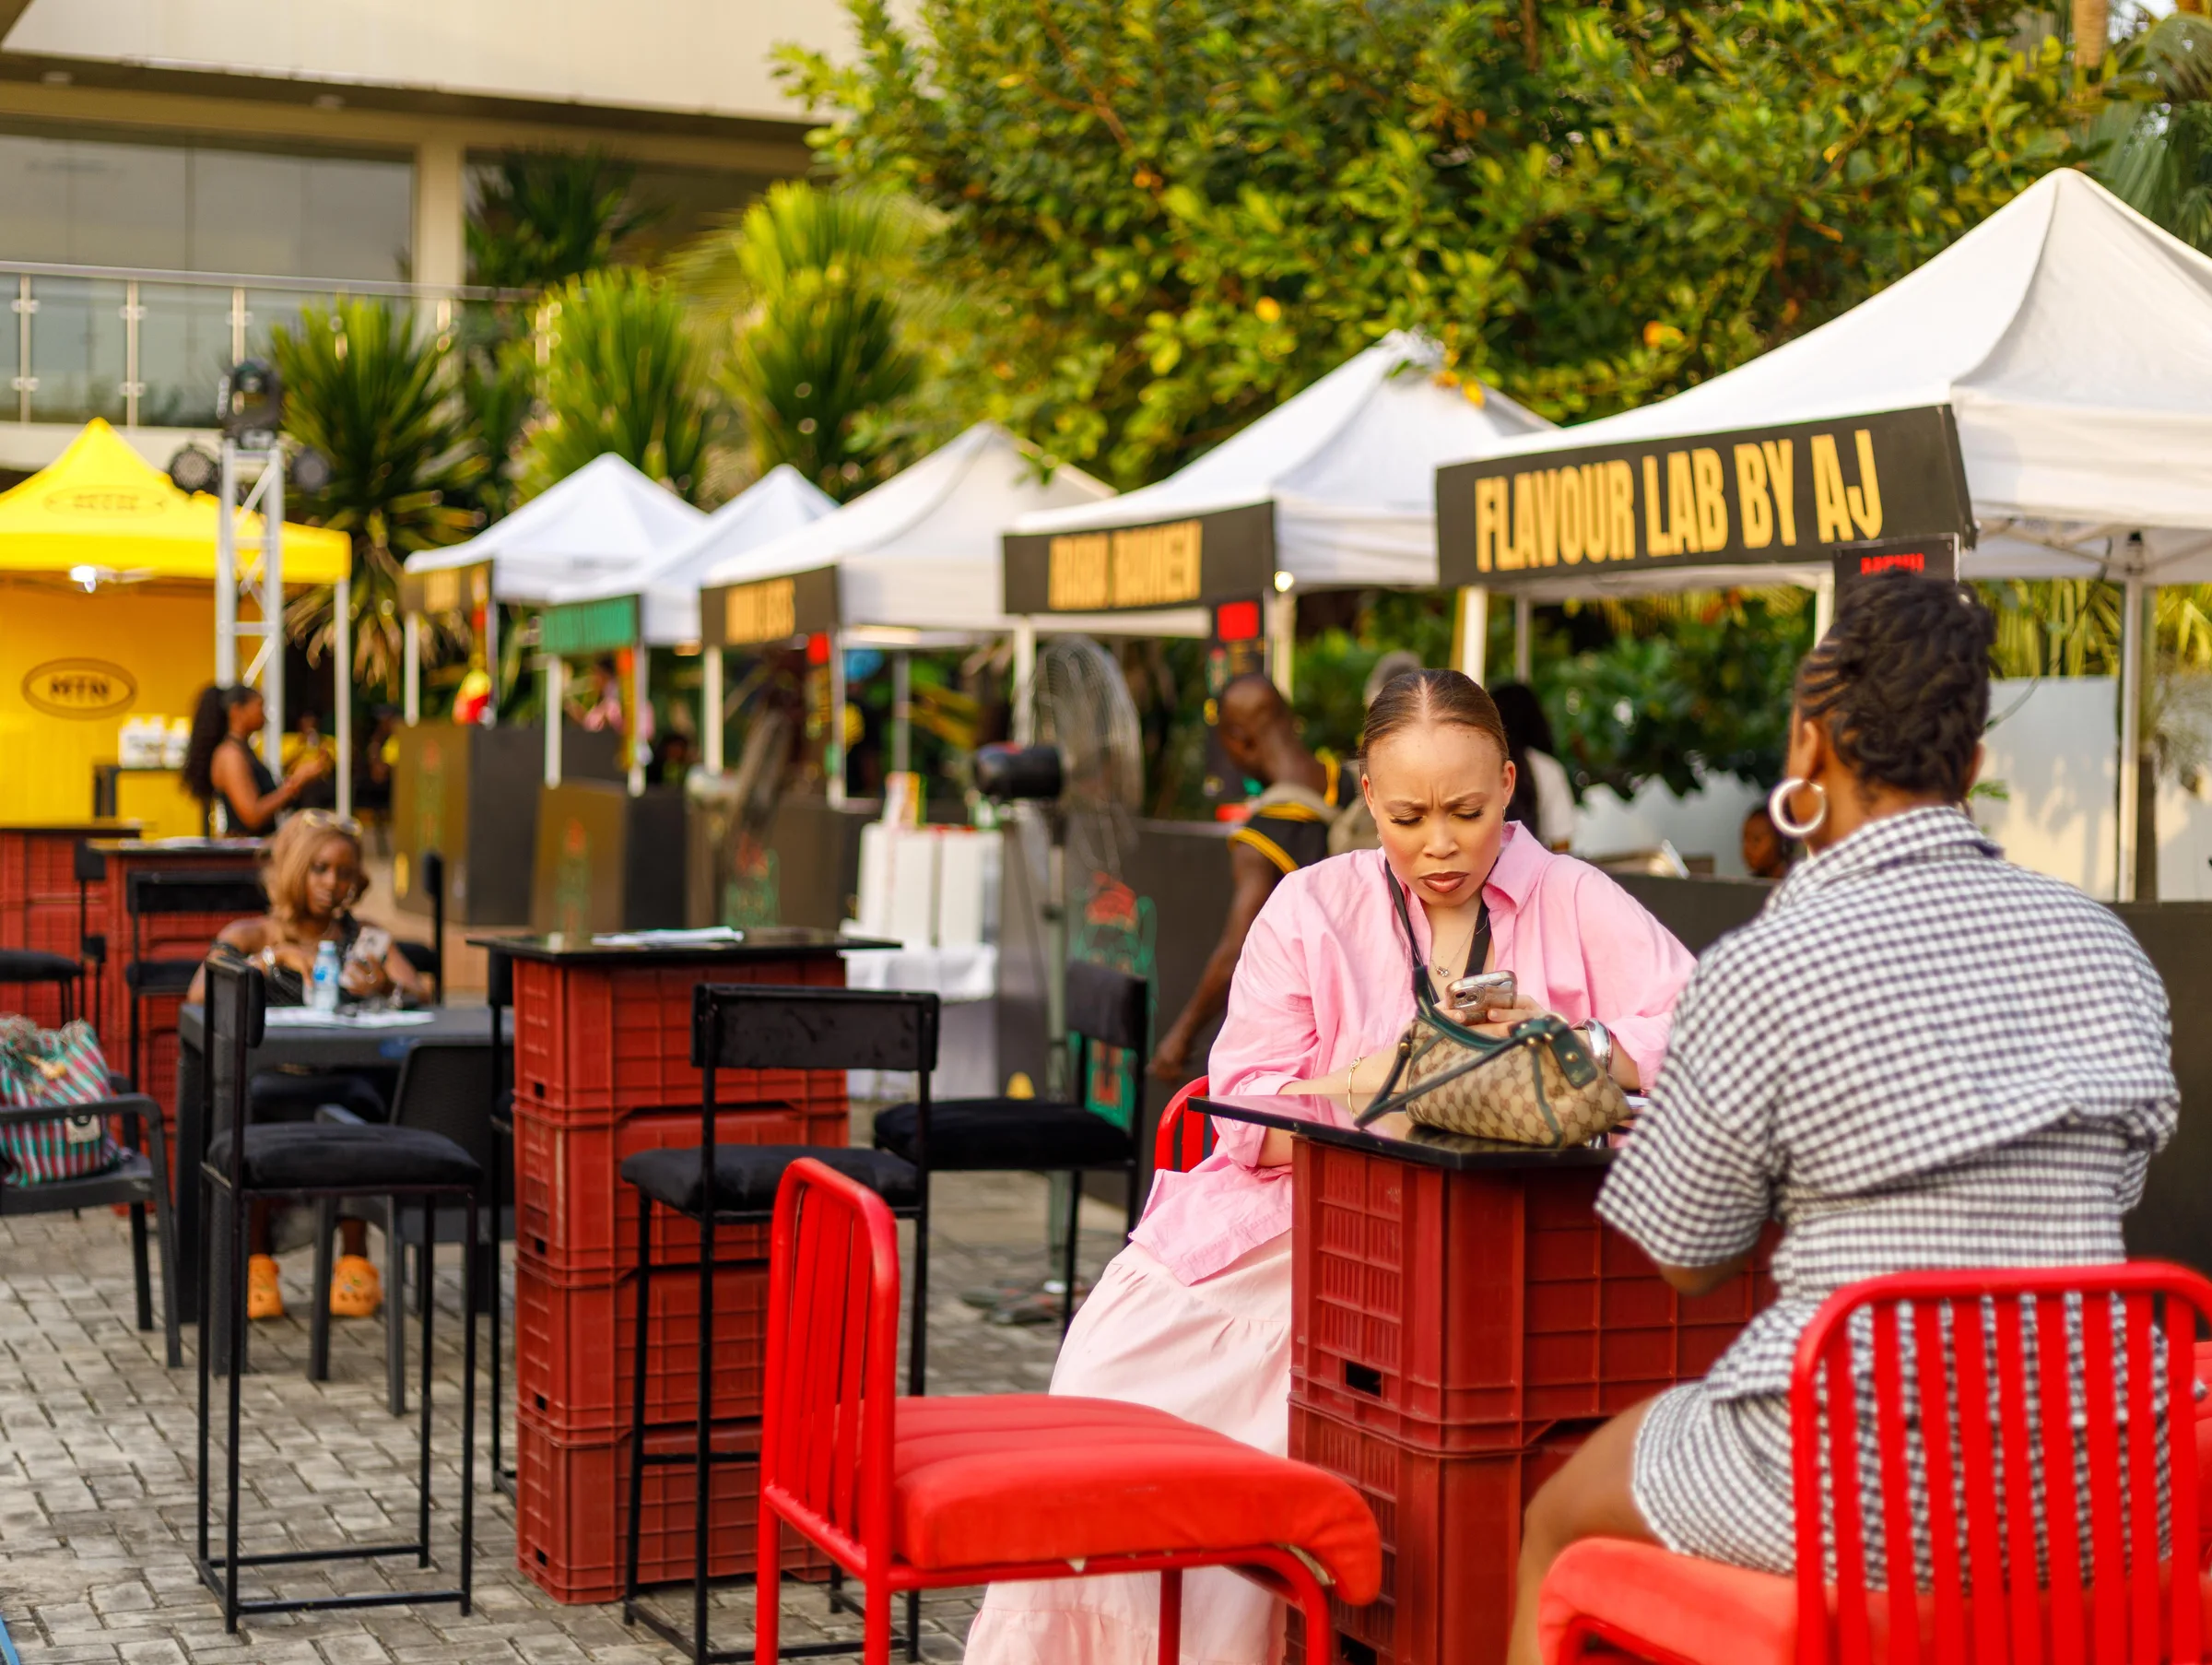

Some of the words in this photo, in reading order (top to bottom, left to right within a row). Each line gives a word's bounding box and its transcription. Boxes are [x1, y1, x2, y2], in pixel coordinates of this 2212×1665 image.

[1476, 459, 1636, 573] FLAVOUR
[1642, 447, 1728, 558] LAB
[1734, 438, 1796, 549] BY
[1810, 429, 1883, 544] AJ
